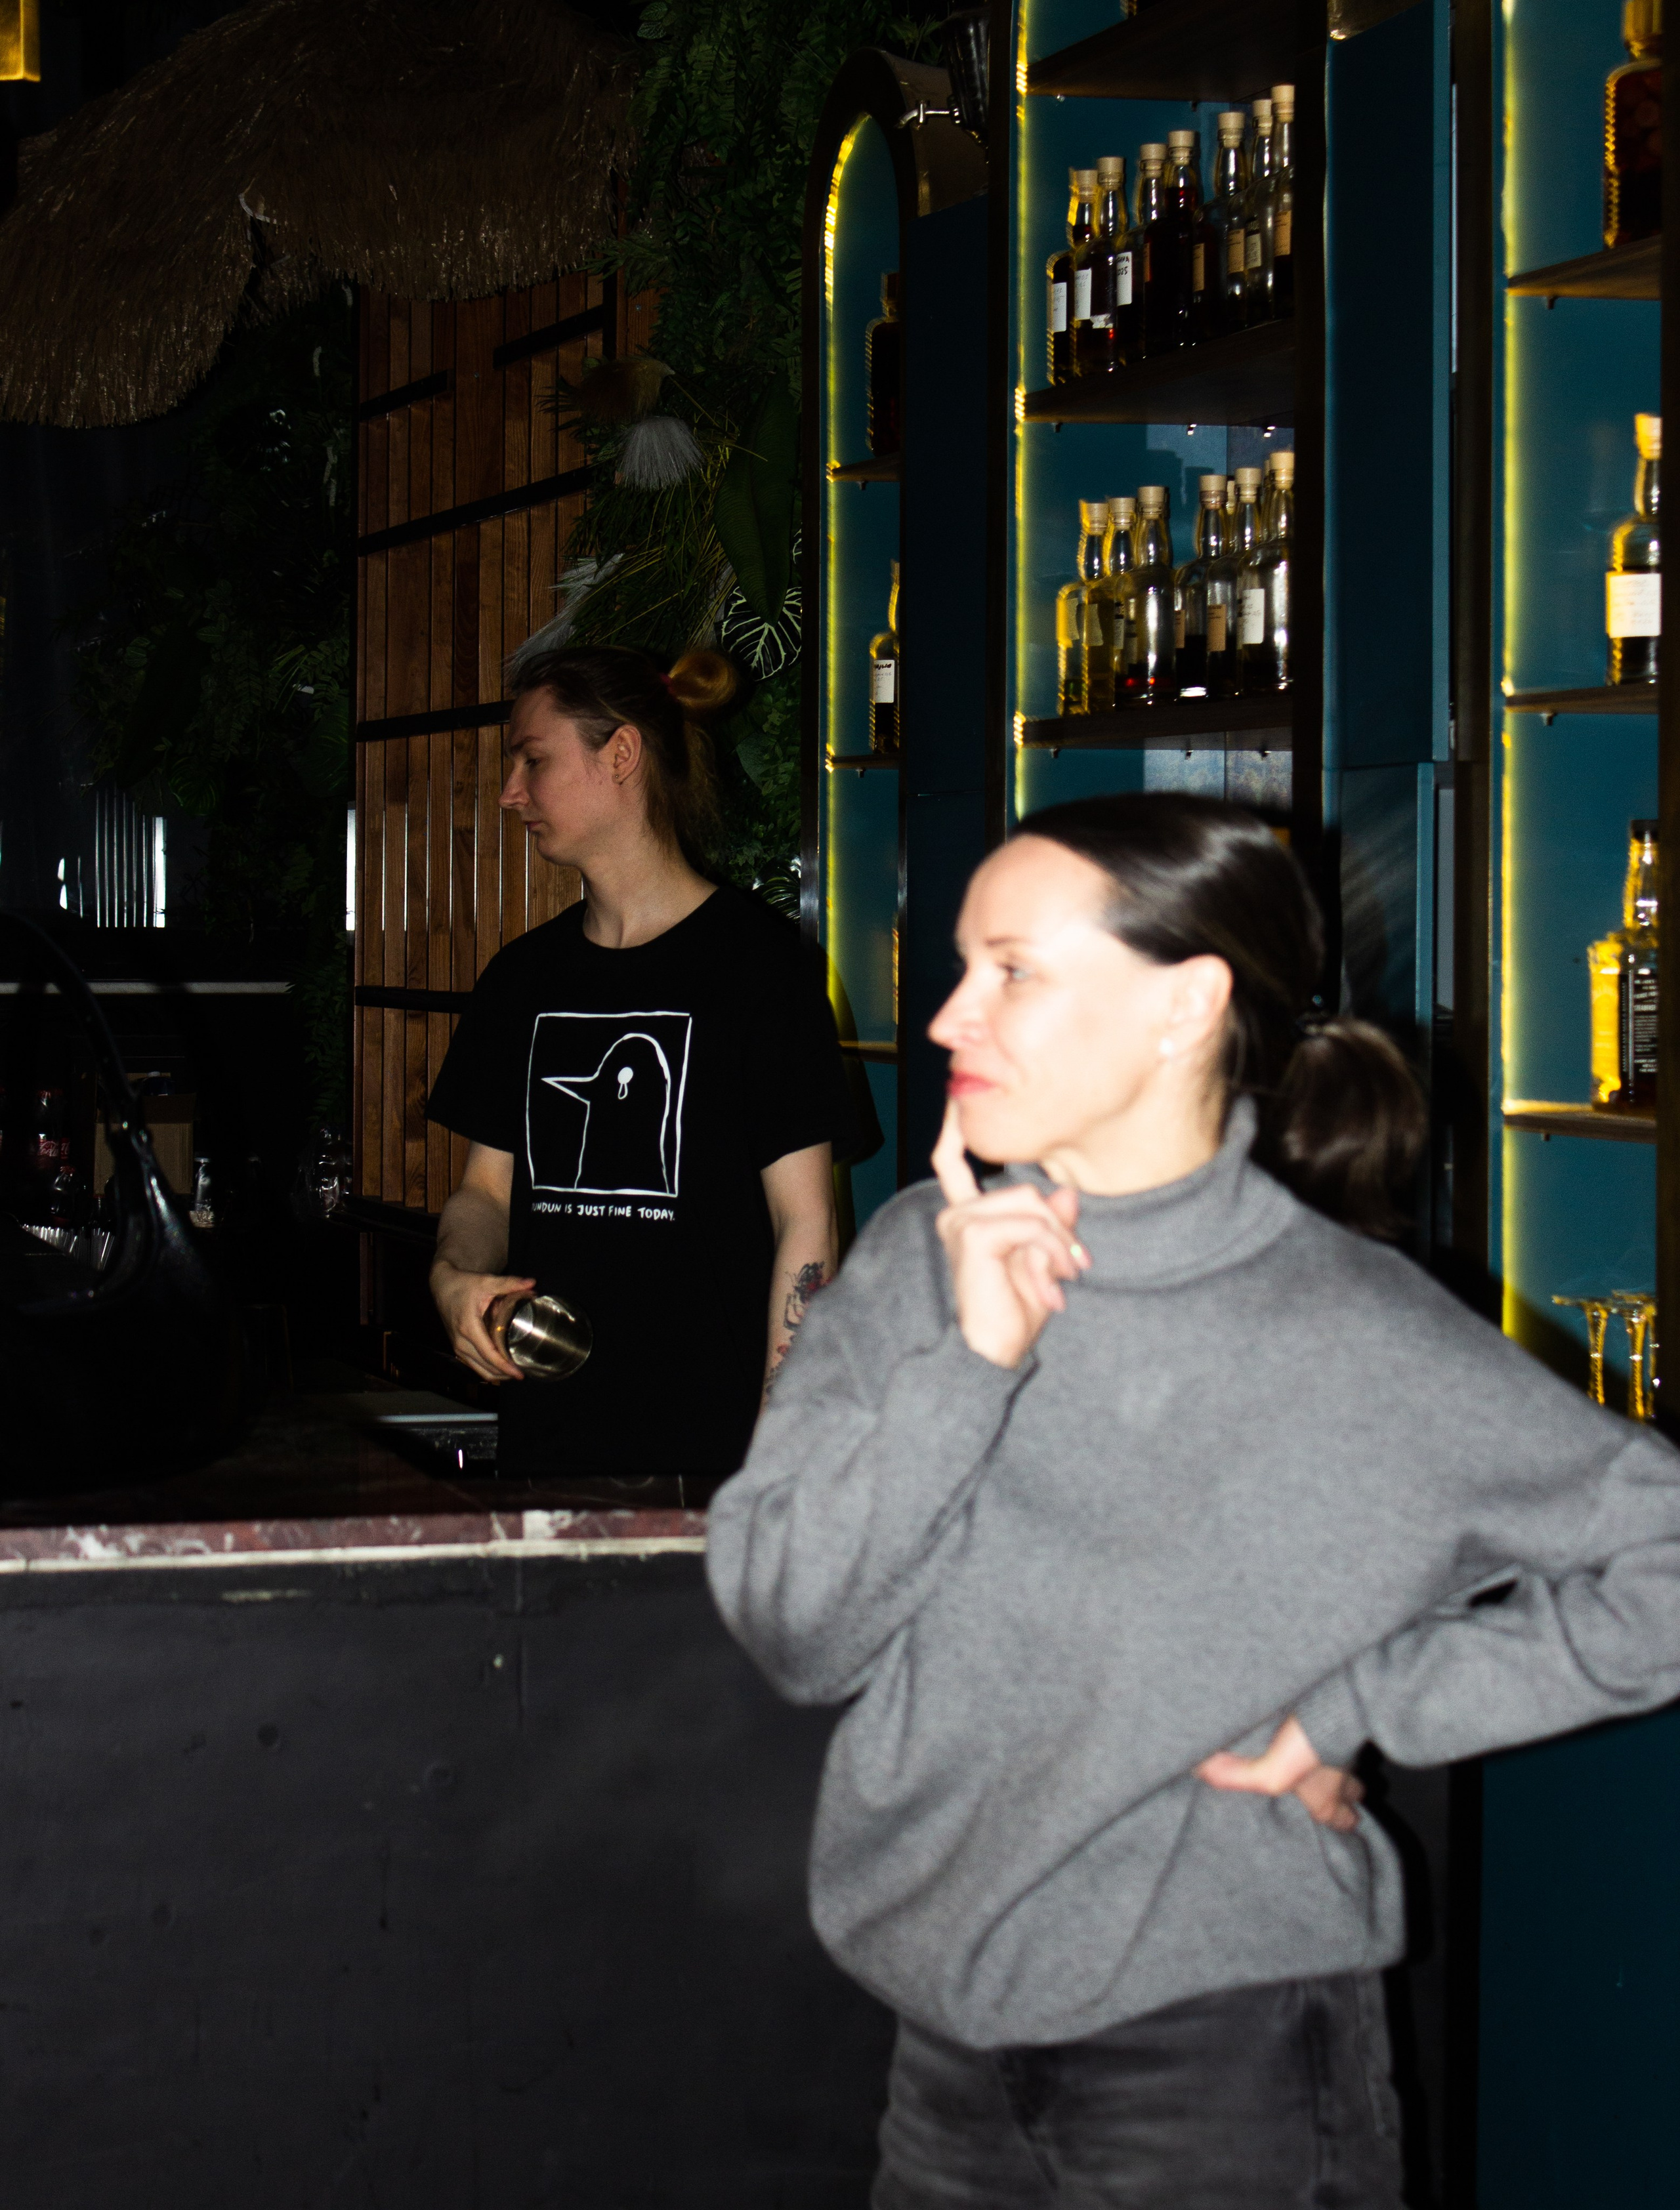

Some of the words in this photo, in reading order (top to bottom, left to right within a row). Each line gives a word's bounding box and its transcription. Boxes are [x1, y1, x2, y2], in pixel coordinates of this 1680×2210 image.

[564, 1203, 572, 1213] IS
[576, 1205, 606, 1216] JUST
[608, 1205, 632, 1217] FINE
[637, 1207, 675, 1221] TODAY.
